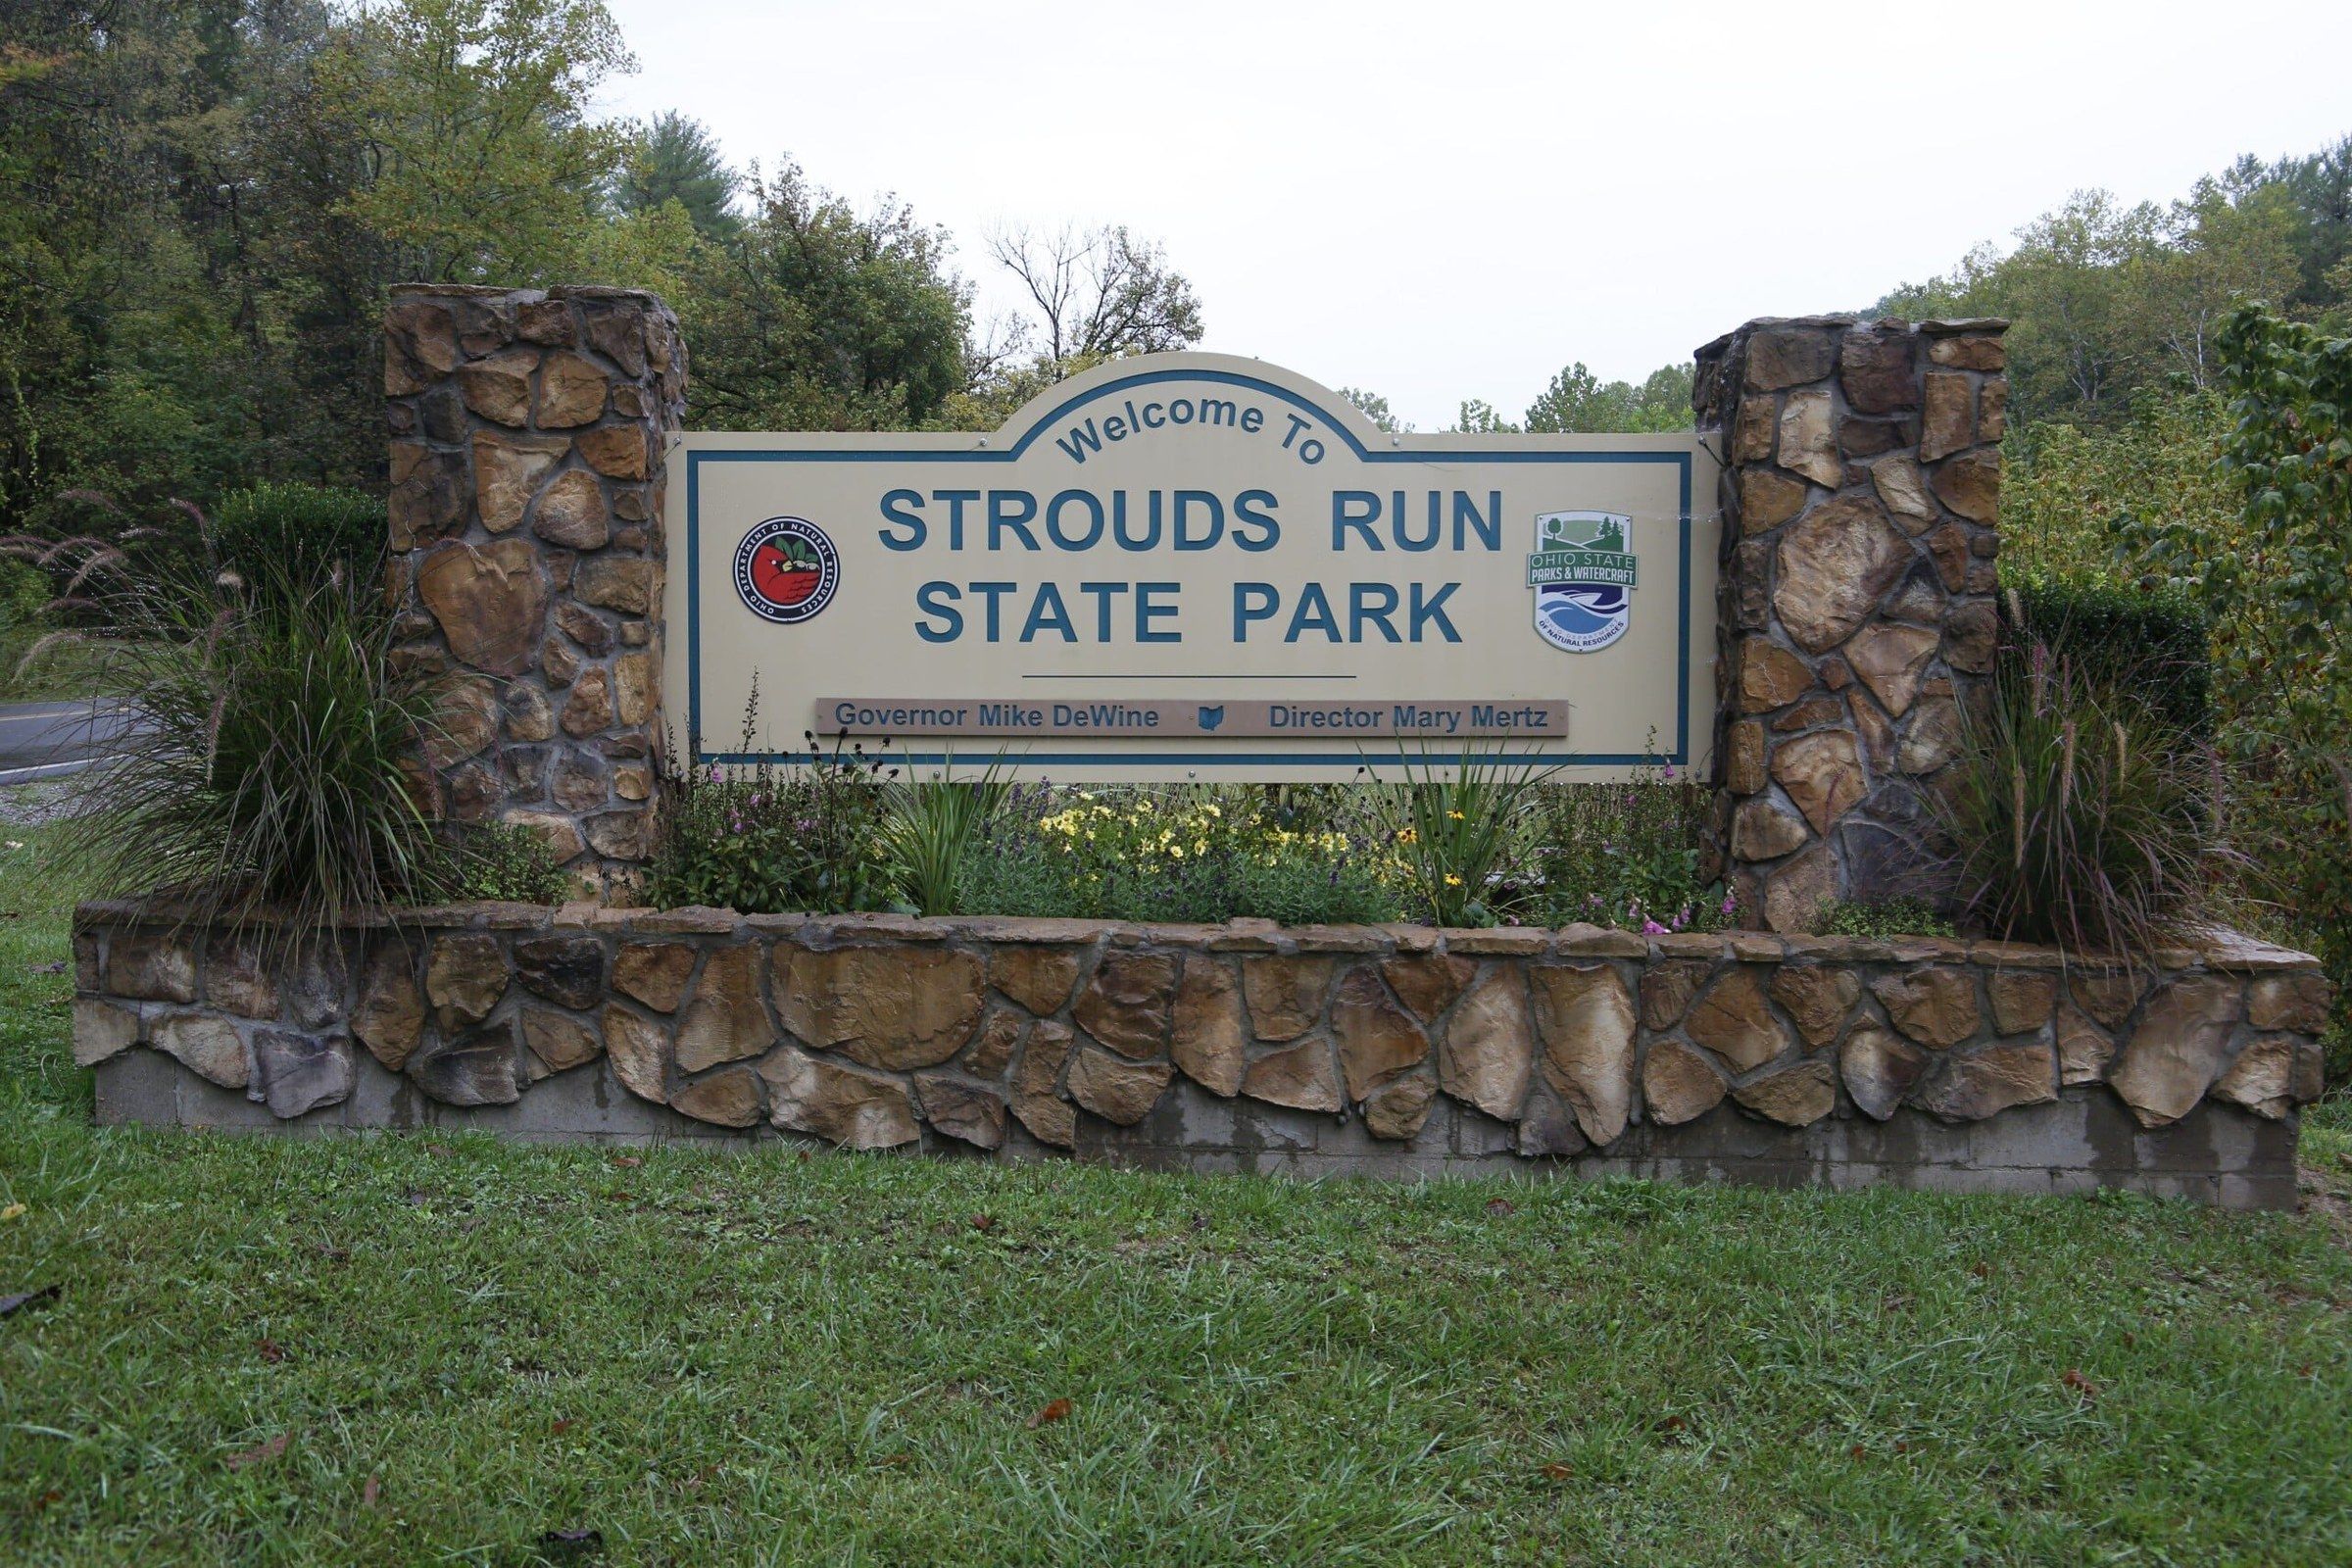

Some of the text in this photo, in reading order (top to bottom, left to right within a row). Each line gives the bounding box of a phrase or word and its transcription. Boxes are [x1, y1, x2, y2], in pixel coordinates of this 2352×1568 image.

[1055, 398, 1325, 466] Welcome To
[877, 488, 1501, 552] STROUDS RUN
[791, 523, 831, 557] NATURAL
[739, 528, 768, 592] DEPARTMENT
[1531, 553, 1634, 569] OHIO STATE
[1532, 566, 1635, 584] PARKS & WATERCRAFT
[801, 562, 834, 613] RESOURCES
[750, 595, 774, 614] OHIO
[914, 581, 1463, 644] STATE PARK
[1539, 619, 1625, 647] OF NATURAL RESOURCES
[835, 703, 1159, 727] Governor Mike DeWine
[1269, 705, 1548, 733] Director Mary Mertz
